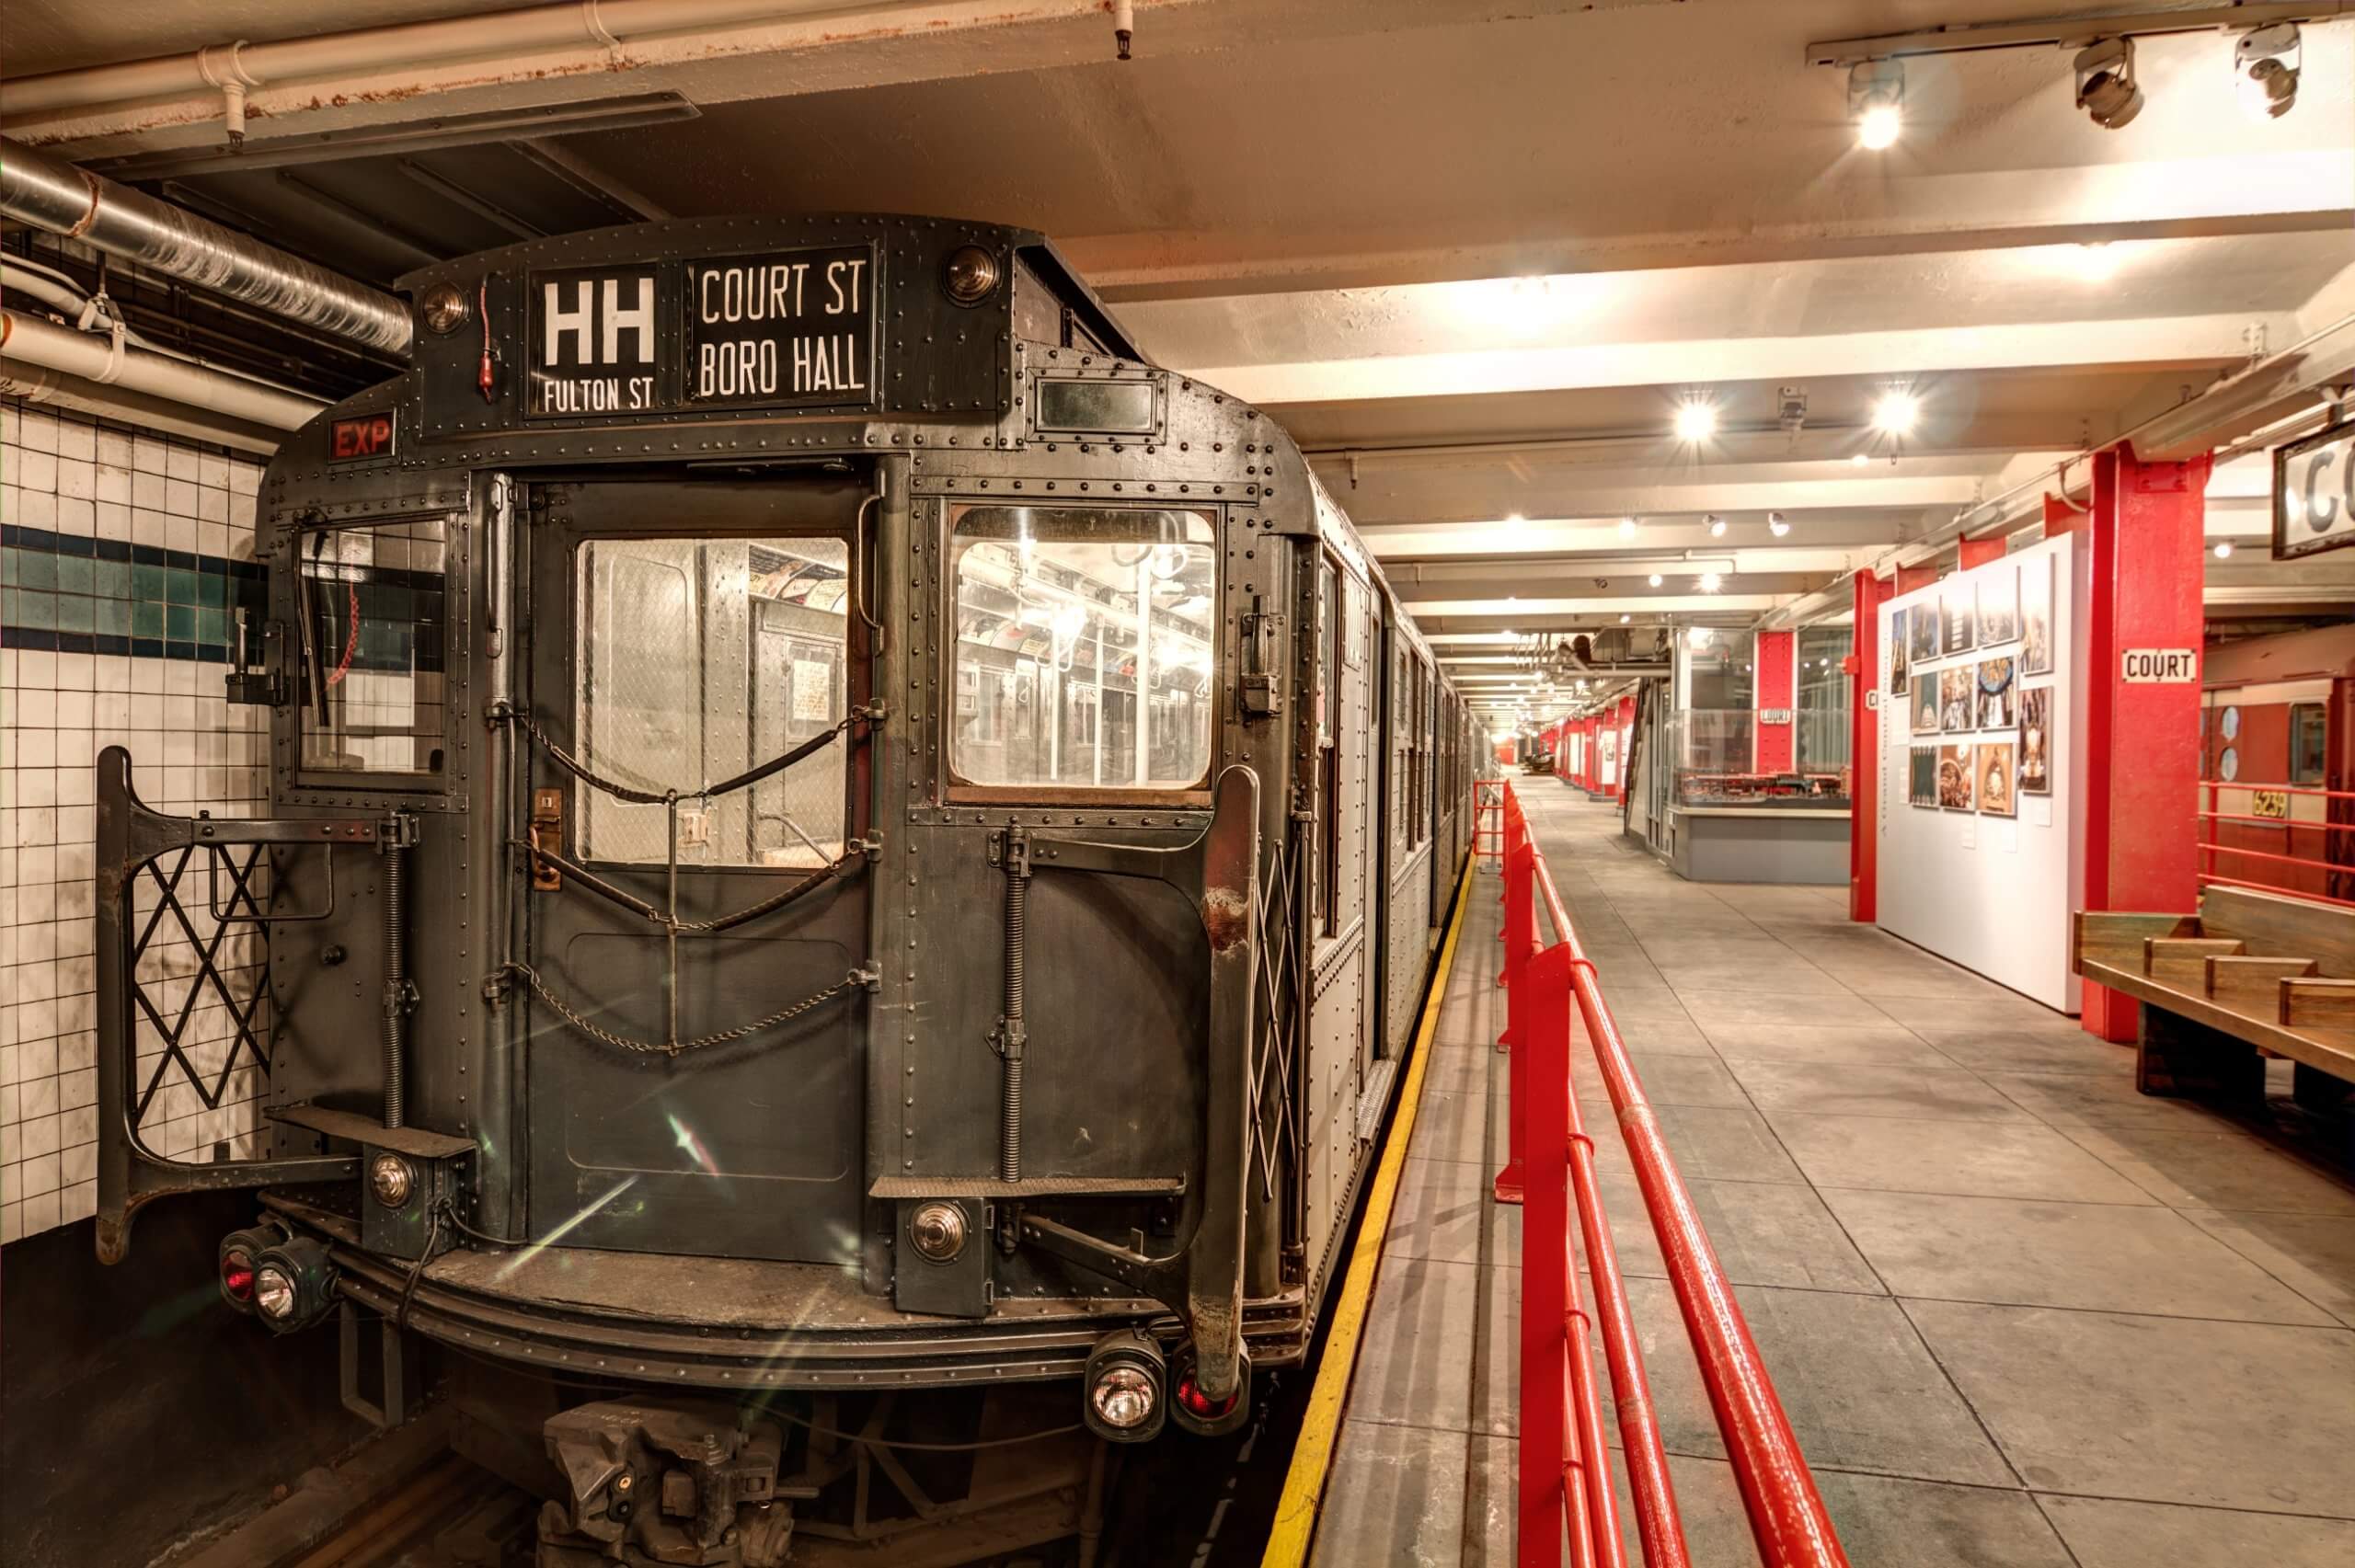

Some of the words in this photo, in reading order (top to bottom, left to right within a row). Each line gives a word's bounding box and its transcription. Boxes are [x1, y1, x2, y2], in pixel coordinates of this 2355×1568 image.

[702, 264, 810, 324] COURT
[824, 259, 867, 315] ST
[545, 278, 655, 366] HH
[700, 339, 777, 397] BORO
[793, 334, 865, 392] HALL
[545, 379, 618, 413] FULTON
[629, 377, 654, 410] ST
[336, 419, 390, 457] EXP
[2126, 654, 2191, 678] COURT
[1868, 692, 1878, 707] C
[2254, 791, 2287, 817] 6239
